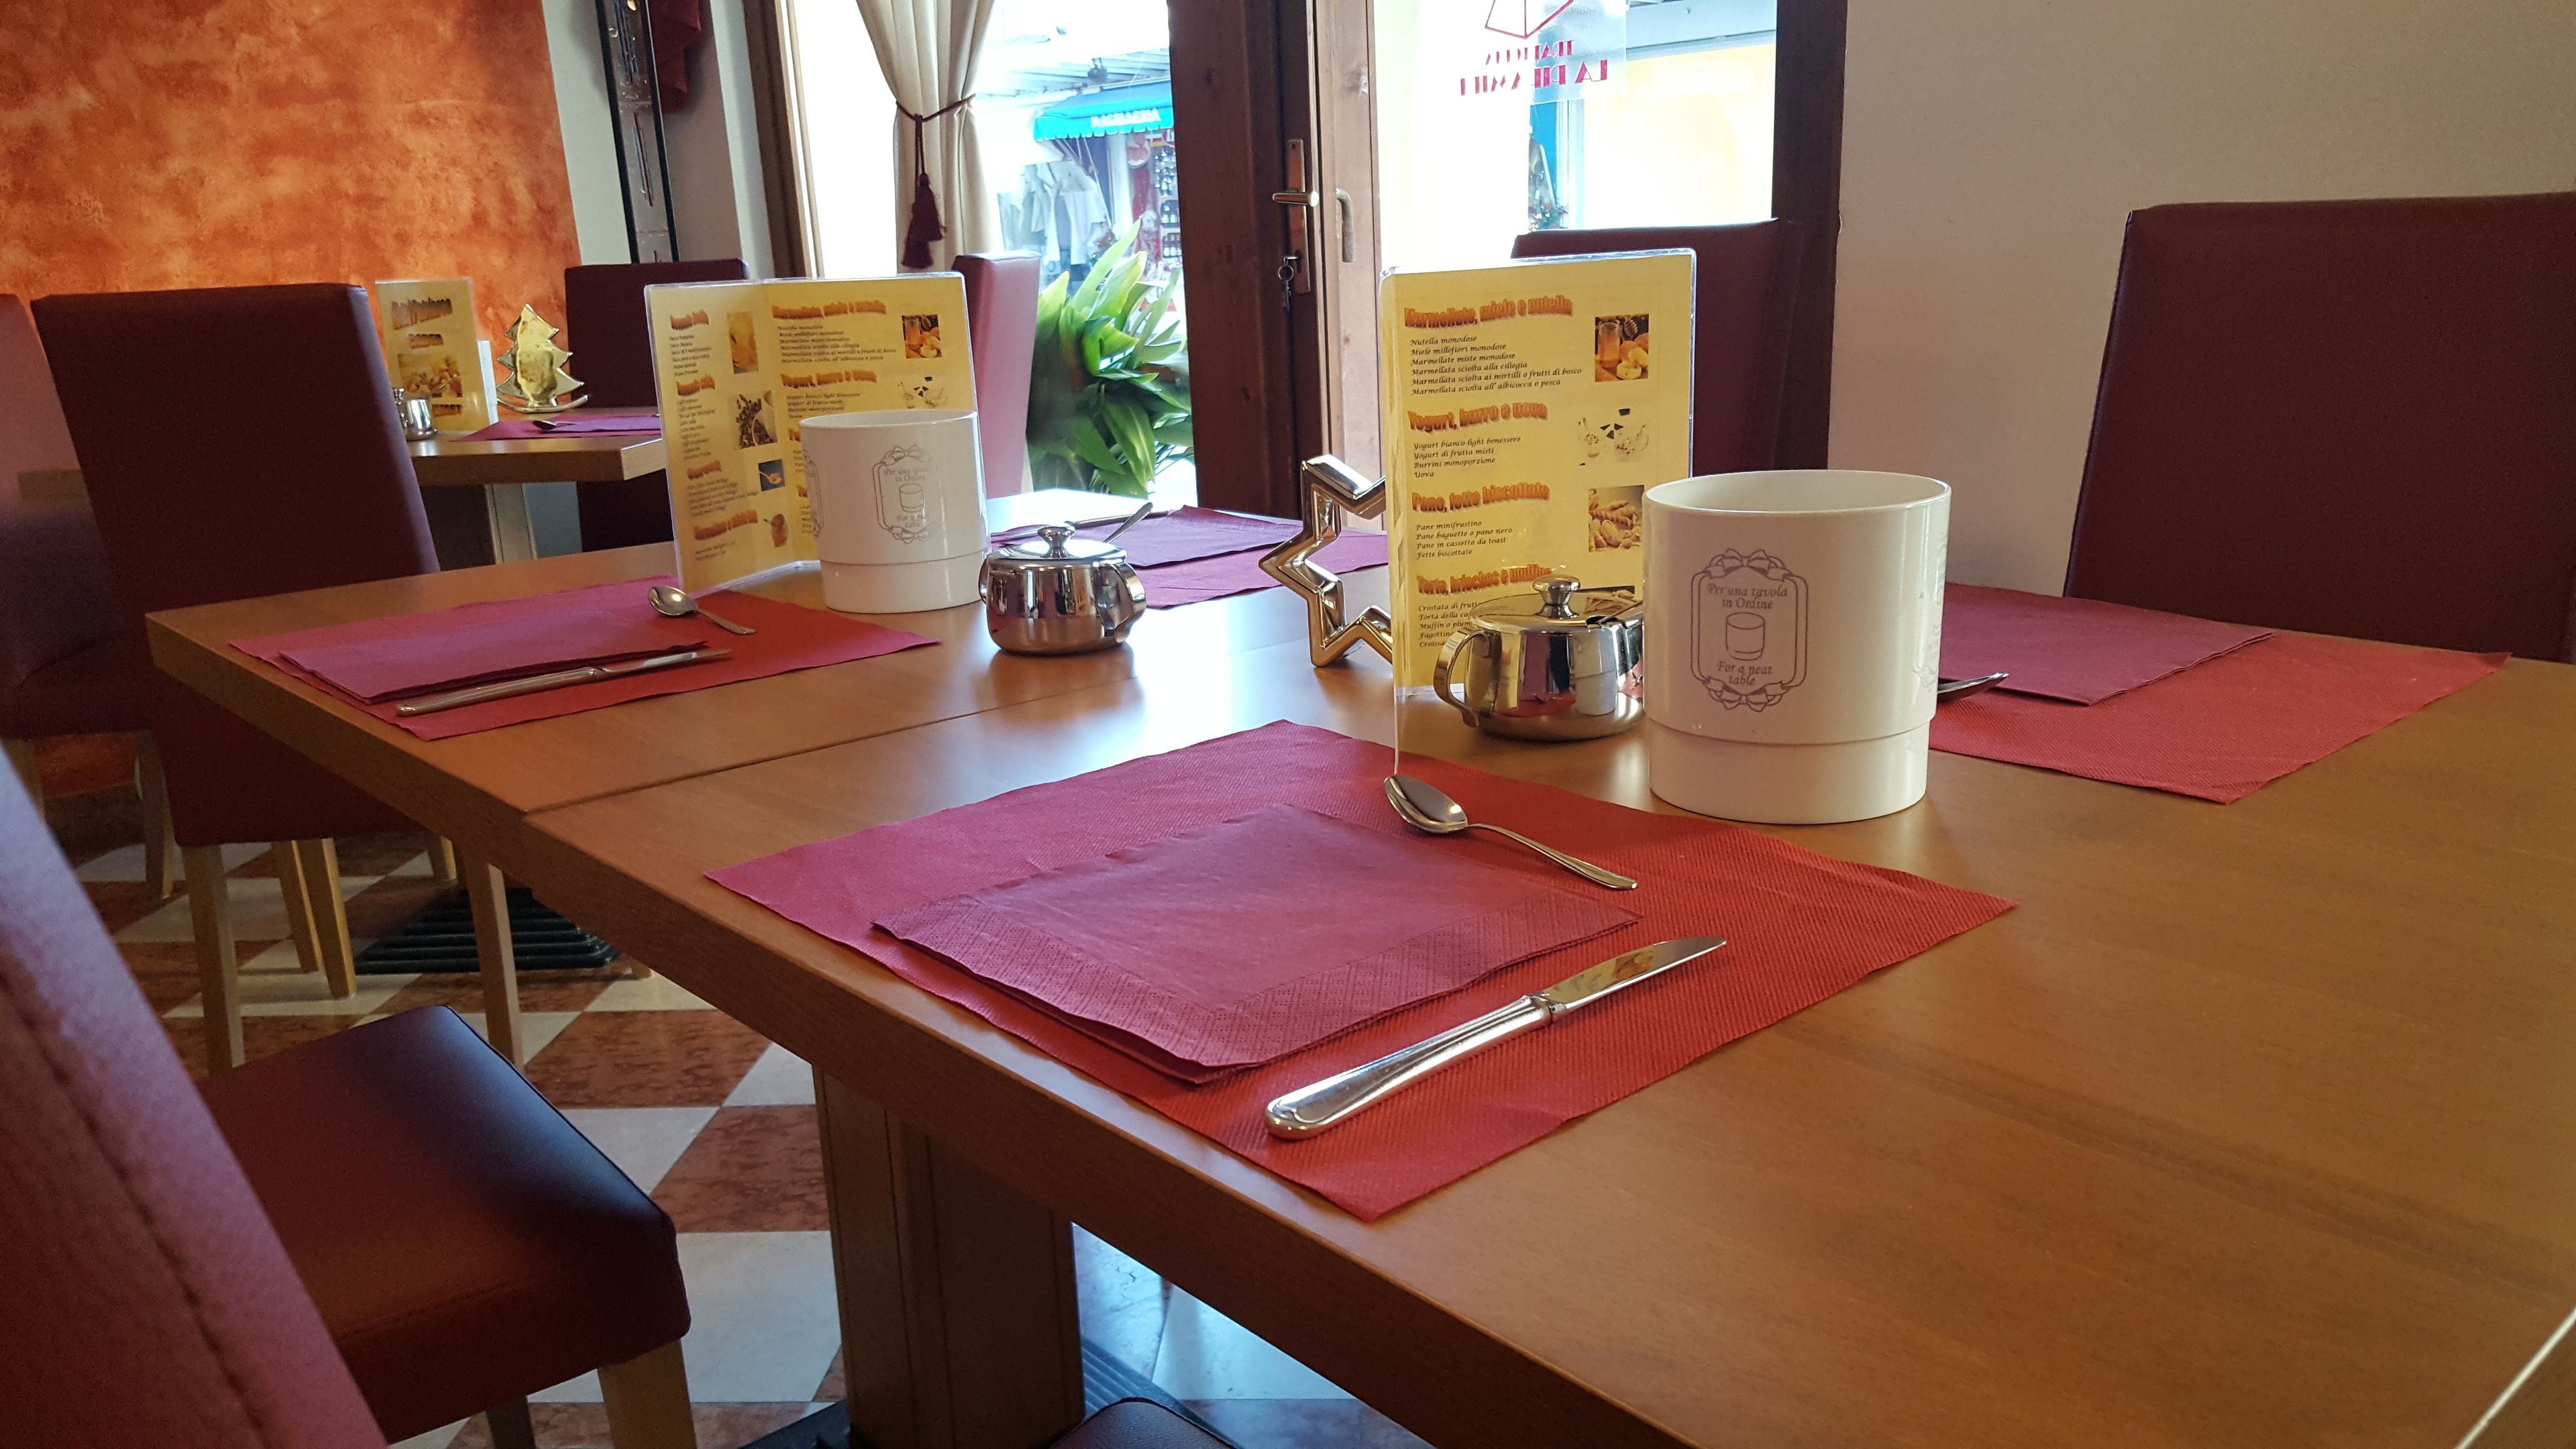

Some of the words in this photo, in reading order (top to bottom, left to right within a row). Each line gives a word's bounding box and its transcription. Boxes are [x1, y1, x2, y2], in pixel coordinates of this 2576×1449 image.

[1517, 299, 1527, 316] e
[1411, 337, 1438, 345] Nutella
[1441, 335, 1477, 344] monodose
[1411, 347, 1431, 356] Miele
[1433, 345, 1468, 355] millefiori
[1470, 343, 1506, 352] monodose
[1411, 357, 1454, 366] Marmellate
[1457, 355, 1477, 363] miste
[1479, 353, 1515, 361] monodose
[1411, 366, 1455, 376] Marmellata
[1458, 364, 1481, 372] sciolta
[1501, 362, 1527, 370] ciliegia
[1412, 376, 1456, 386] Marmellata
[1458, 374, 1481, 382] sciolta
[1493, 371, 1521, 380] mirtilli
[1528, 370, 1550, 380] frutti
[1412, 386, 1456, 395] Marmellata
[1458, 384, 1481, 392] sciolta
[1498, 382, 1532, 390] albicocca
[1541, 380, 1560, 388] pesca
[1501, 404, 1510, 420] e
[1413, 442, 1438, 451] Yogurt
[1441, 439, 1465, 447] bianco
[1467, 438, 1484, 447] light
[1487, 436, 1521, 445] benessere
[1414, 452, 1438, 460] Yogurt
[1442, 449, 1448, 458] di
[1449, 449, 1472, 459] frutta
[1476, 447, 1495, 455] misti
[1414, 460, 1442, 469] Burrini
[1444, 458, 1496, 468] monoporzione
[1416, 524, 1434, 532] Pane
[1436, 521, 1482, 530] minifrustino
[1436, 531, 1468, 540] baguette
[1475, 529, 1493, 537] pane
[1446, 539, 1475, 547] cassetta
[1417, 551, 1435, 560] Fette
[1437, 549, 1472, 557] biscottate
[1501, 569, 1509, 585] e
[1707, 583, 1723, 596] Per
[1728, 587, 1747, 596] una
[1752, 584, 1788, 596] tavola
[1458, 601, 1477, 610] frutt
[1722, 597, 1733, 607] in
[1736, 597, 1773, 609] Ordine
[1419, 622, 1444, 630] Muffin
[1452, 621, 1472, 629] plum
[1717, 661, 1736, 672] For
[1738, 665, 1746, 674] a
[1748, 665, 1773, 675] neat
[1729, 674, 1756, 686] table
